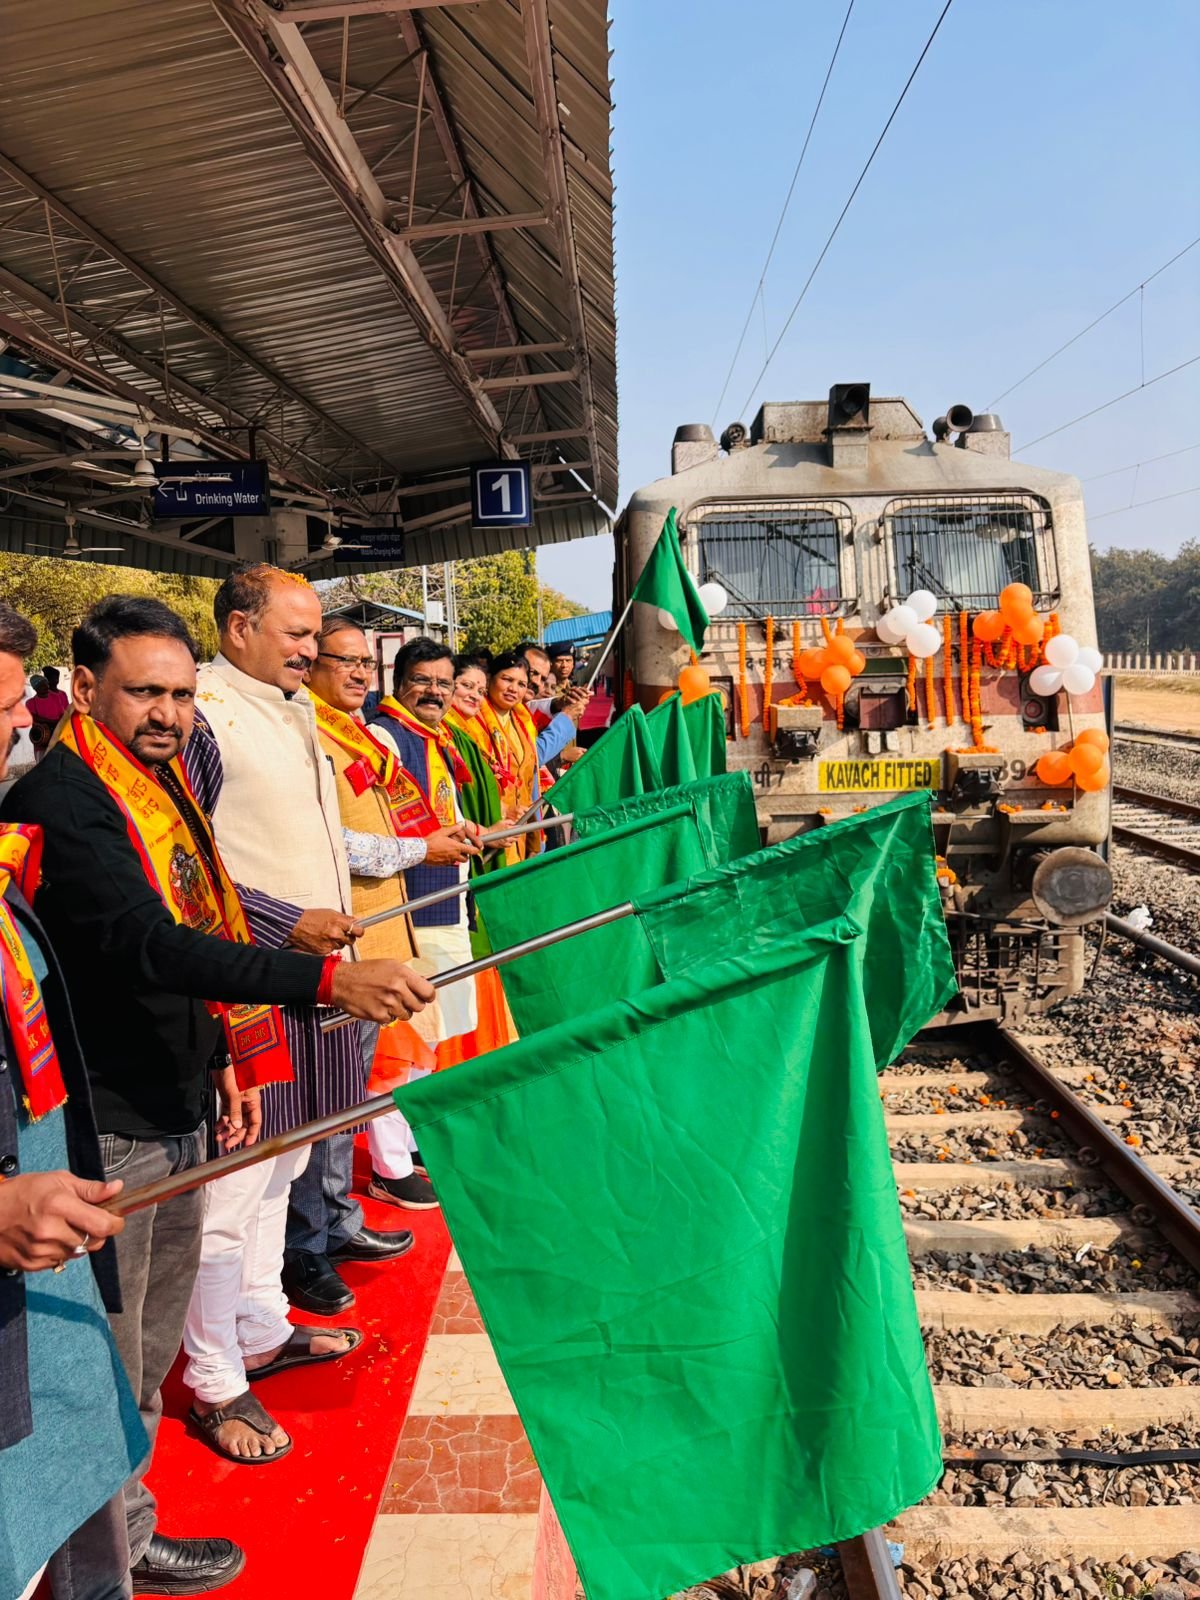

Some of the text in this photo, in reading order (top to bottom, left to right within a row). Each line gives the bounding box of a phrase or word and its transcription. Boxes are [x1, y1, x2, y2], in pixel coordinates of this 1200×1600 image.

[195, 492, 259, 507] Drinking Water
[491, 474, 511, 512] 1
[826, 761, 932, 789] KAVACH FITTED
